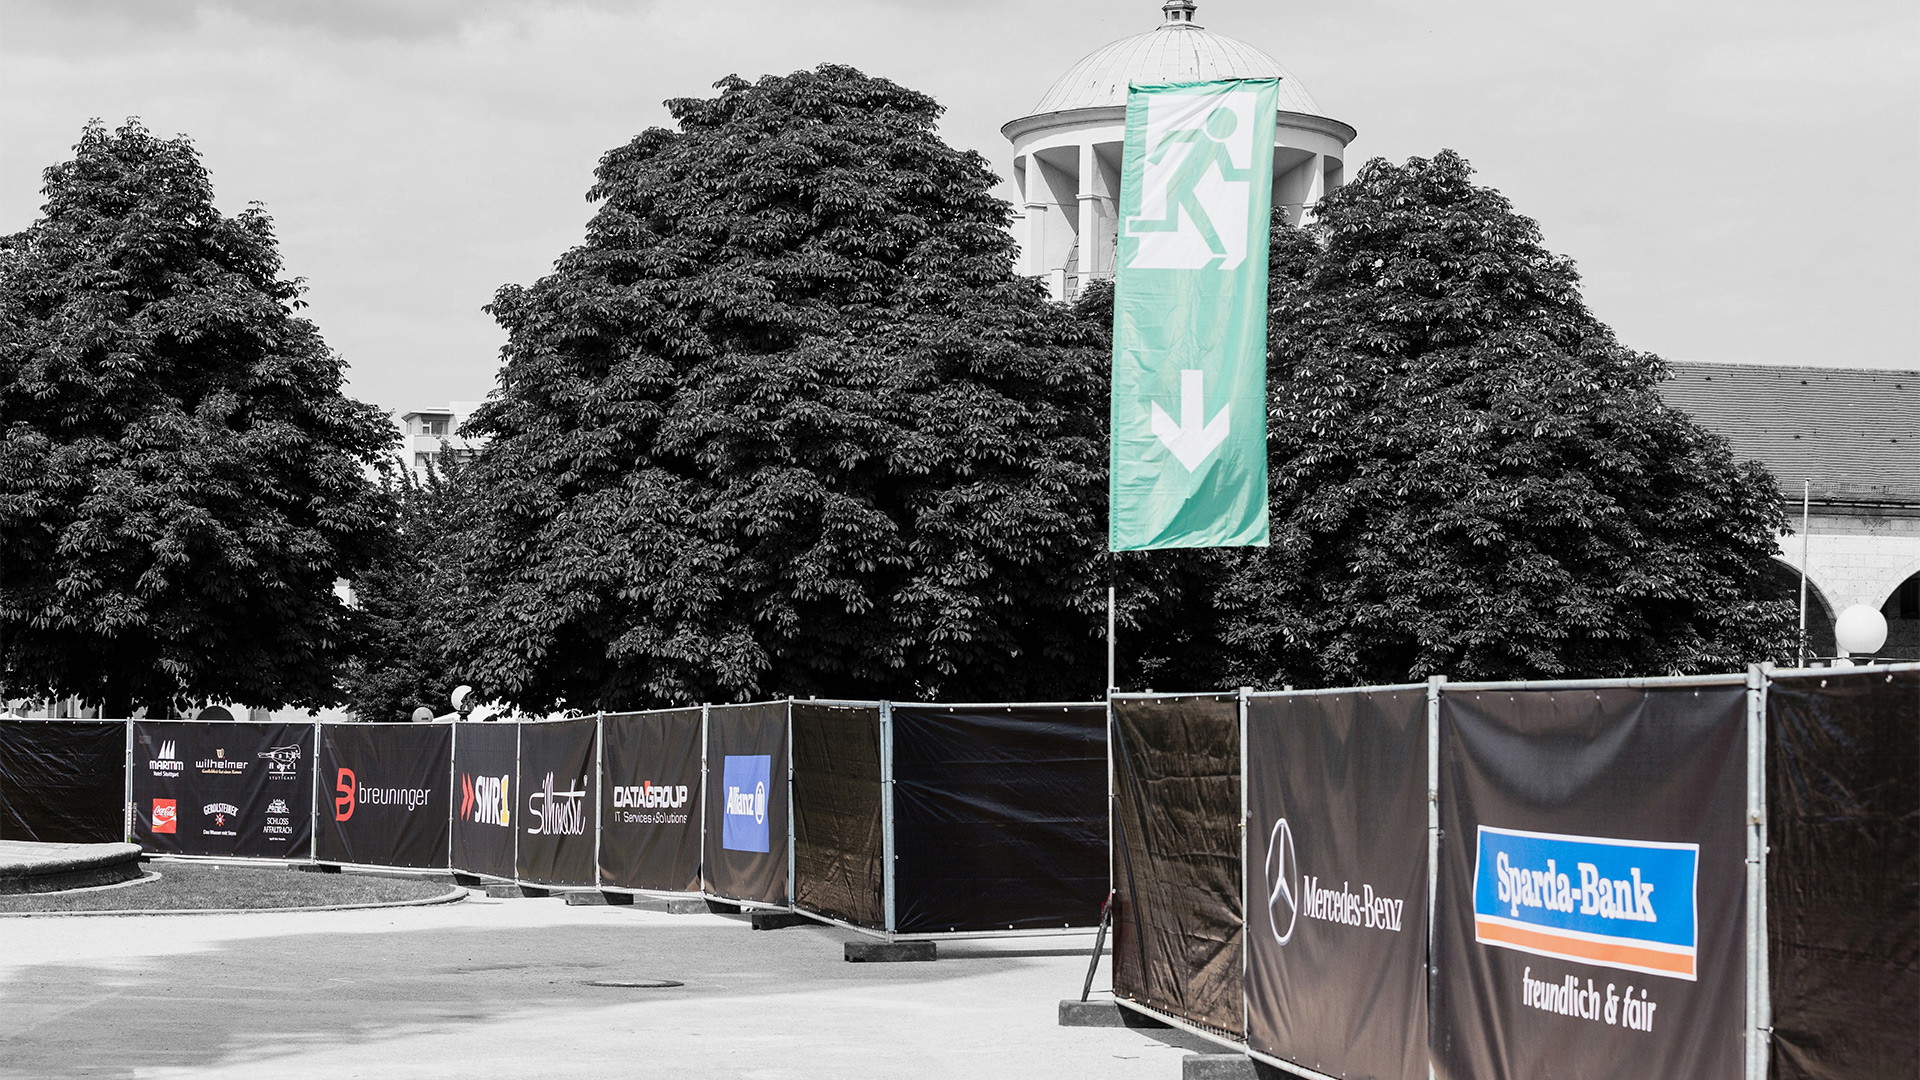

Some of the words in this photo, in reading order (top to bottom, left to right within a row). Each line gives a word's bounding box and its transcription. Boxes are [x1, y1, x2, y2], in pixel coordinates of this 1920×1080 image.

[195, 759, 248, 770] wilhelmer
[359, 782, 431, 811] breuninger
[474, 774, 510, 827] SWR1
[613, 785, 688, 808] DATAGROUP
[266, 817, 289, 825] SCHLOSS
[614, 811, 621, 822] IT
[1496, 851, 1657, 923] Sparda-Bank
[1303, 875, 1404, 932] Mercedes-Benz
[1522, 966, 1601, 1021] freundlich
[1604, 983, 1620, 1025] &
[1622, 985, 1657, 1032] fair
